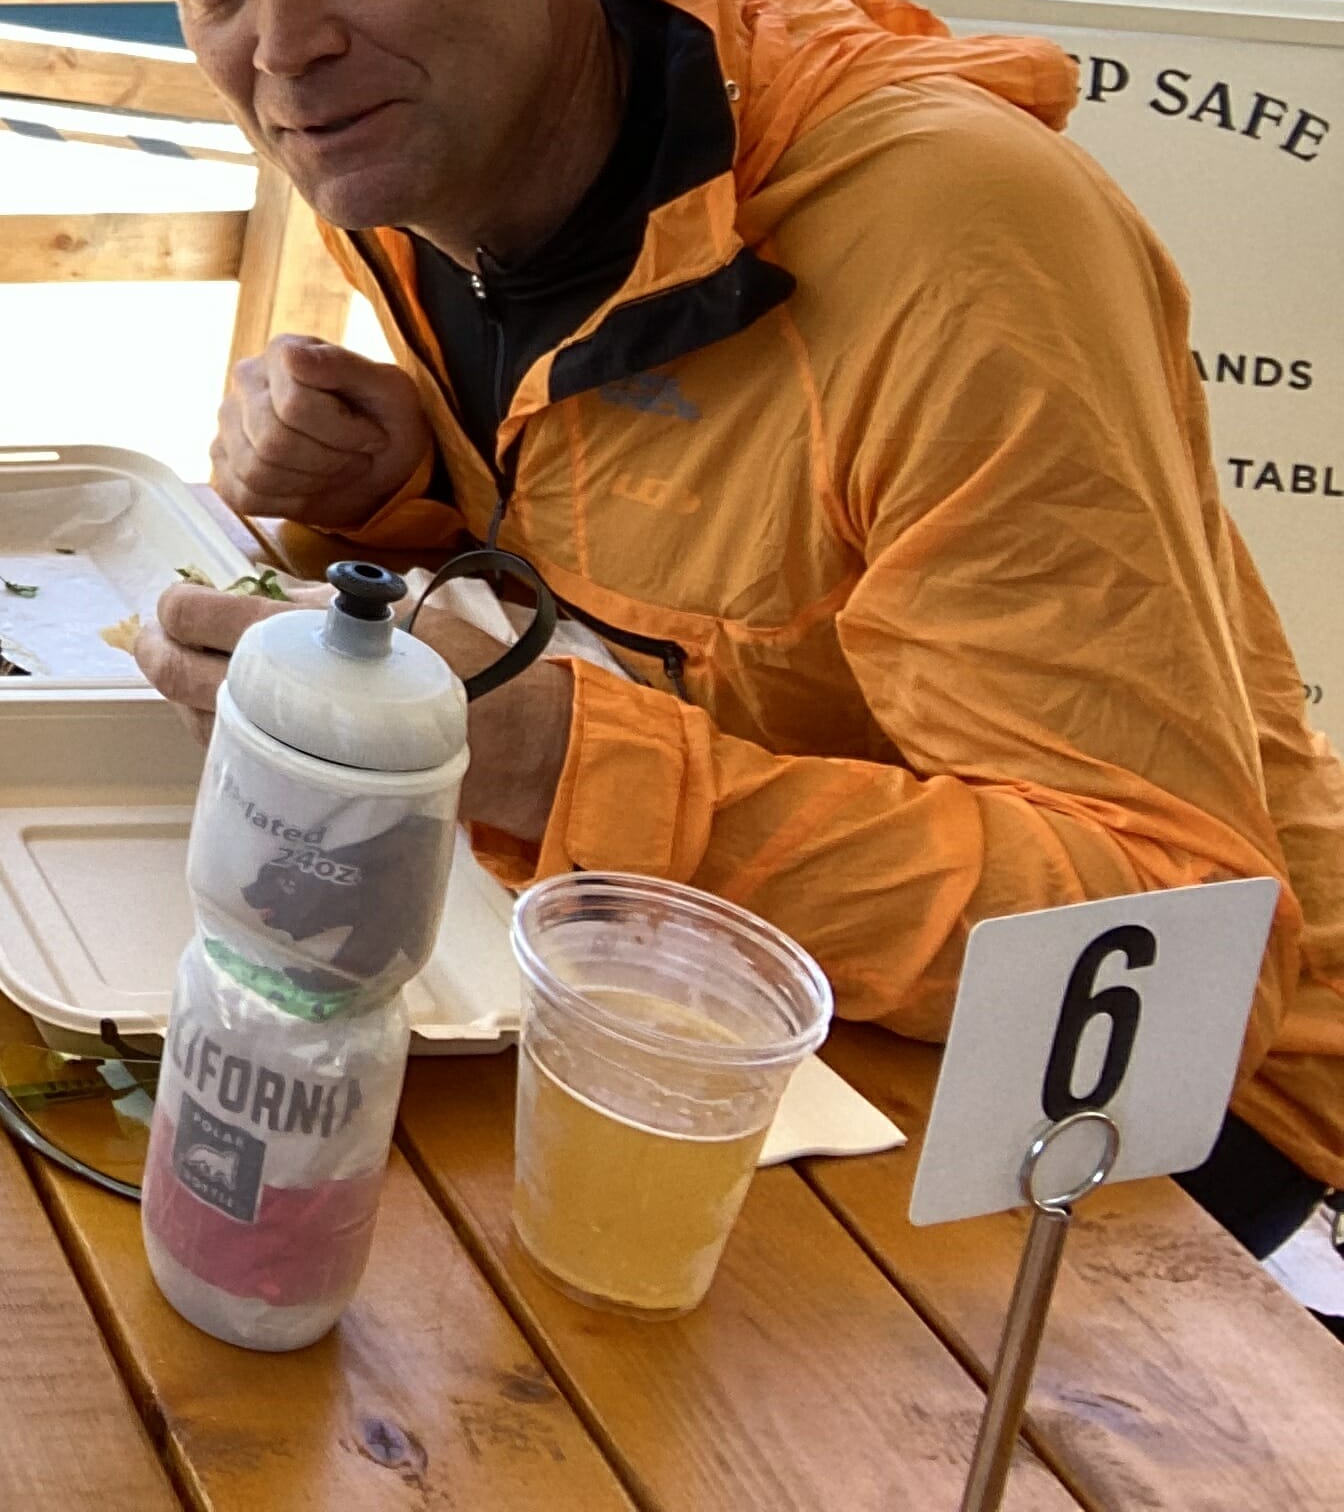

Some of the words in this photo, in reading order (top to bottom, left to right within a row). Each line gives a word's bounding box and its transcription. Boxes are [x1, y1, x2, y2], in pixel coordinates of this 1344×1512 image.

[1065, 53, 1130, 103] P
[1149, 68, 1330, 162] SAFE
[1042, 924, 1157, 1123] 6
[193, 1111, 244, 1146] POLAR
